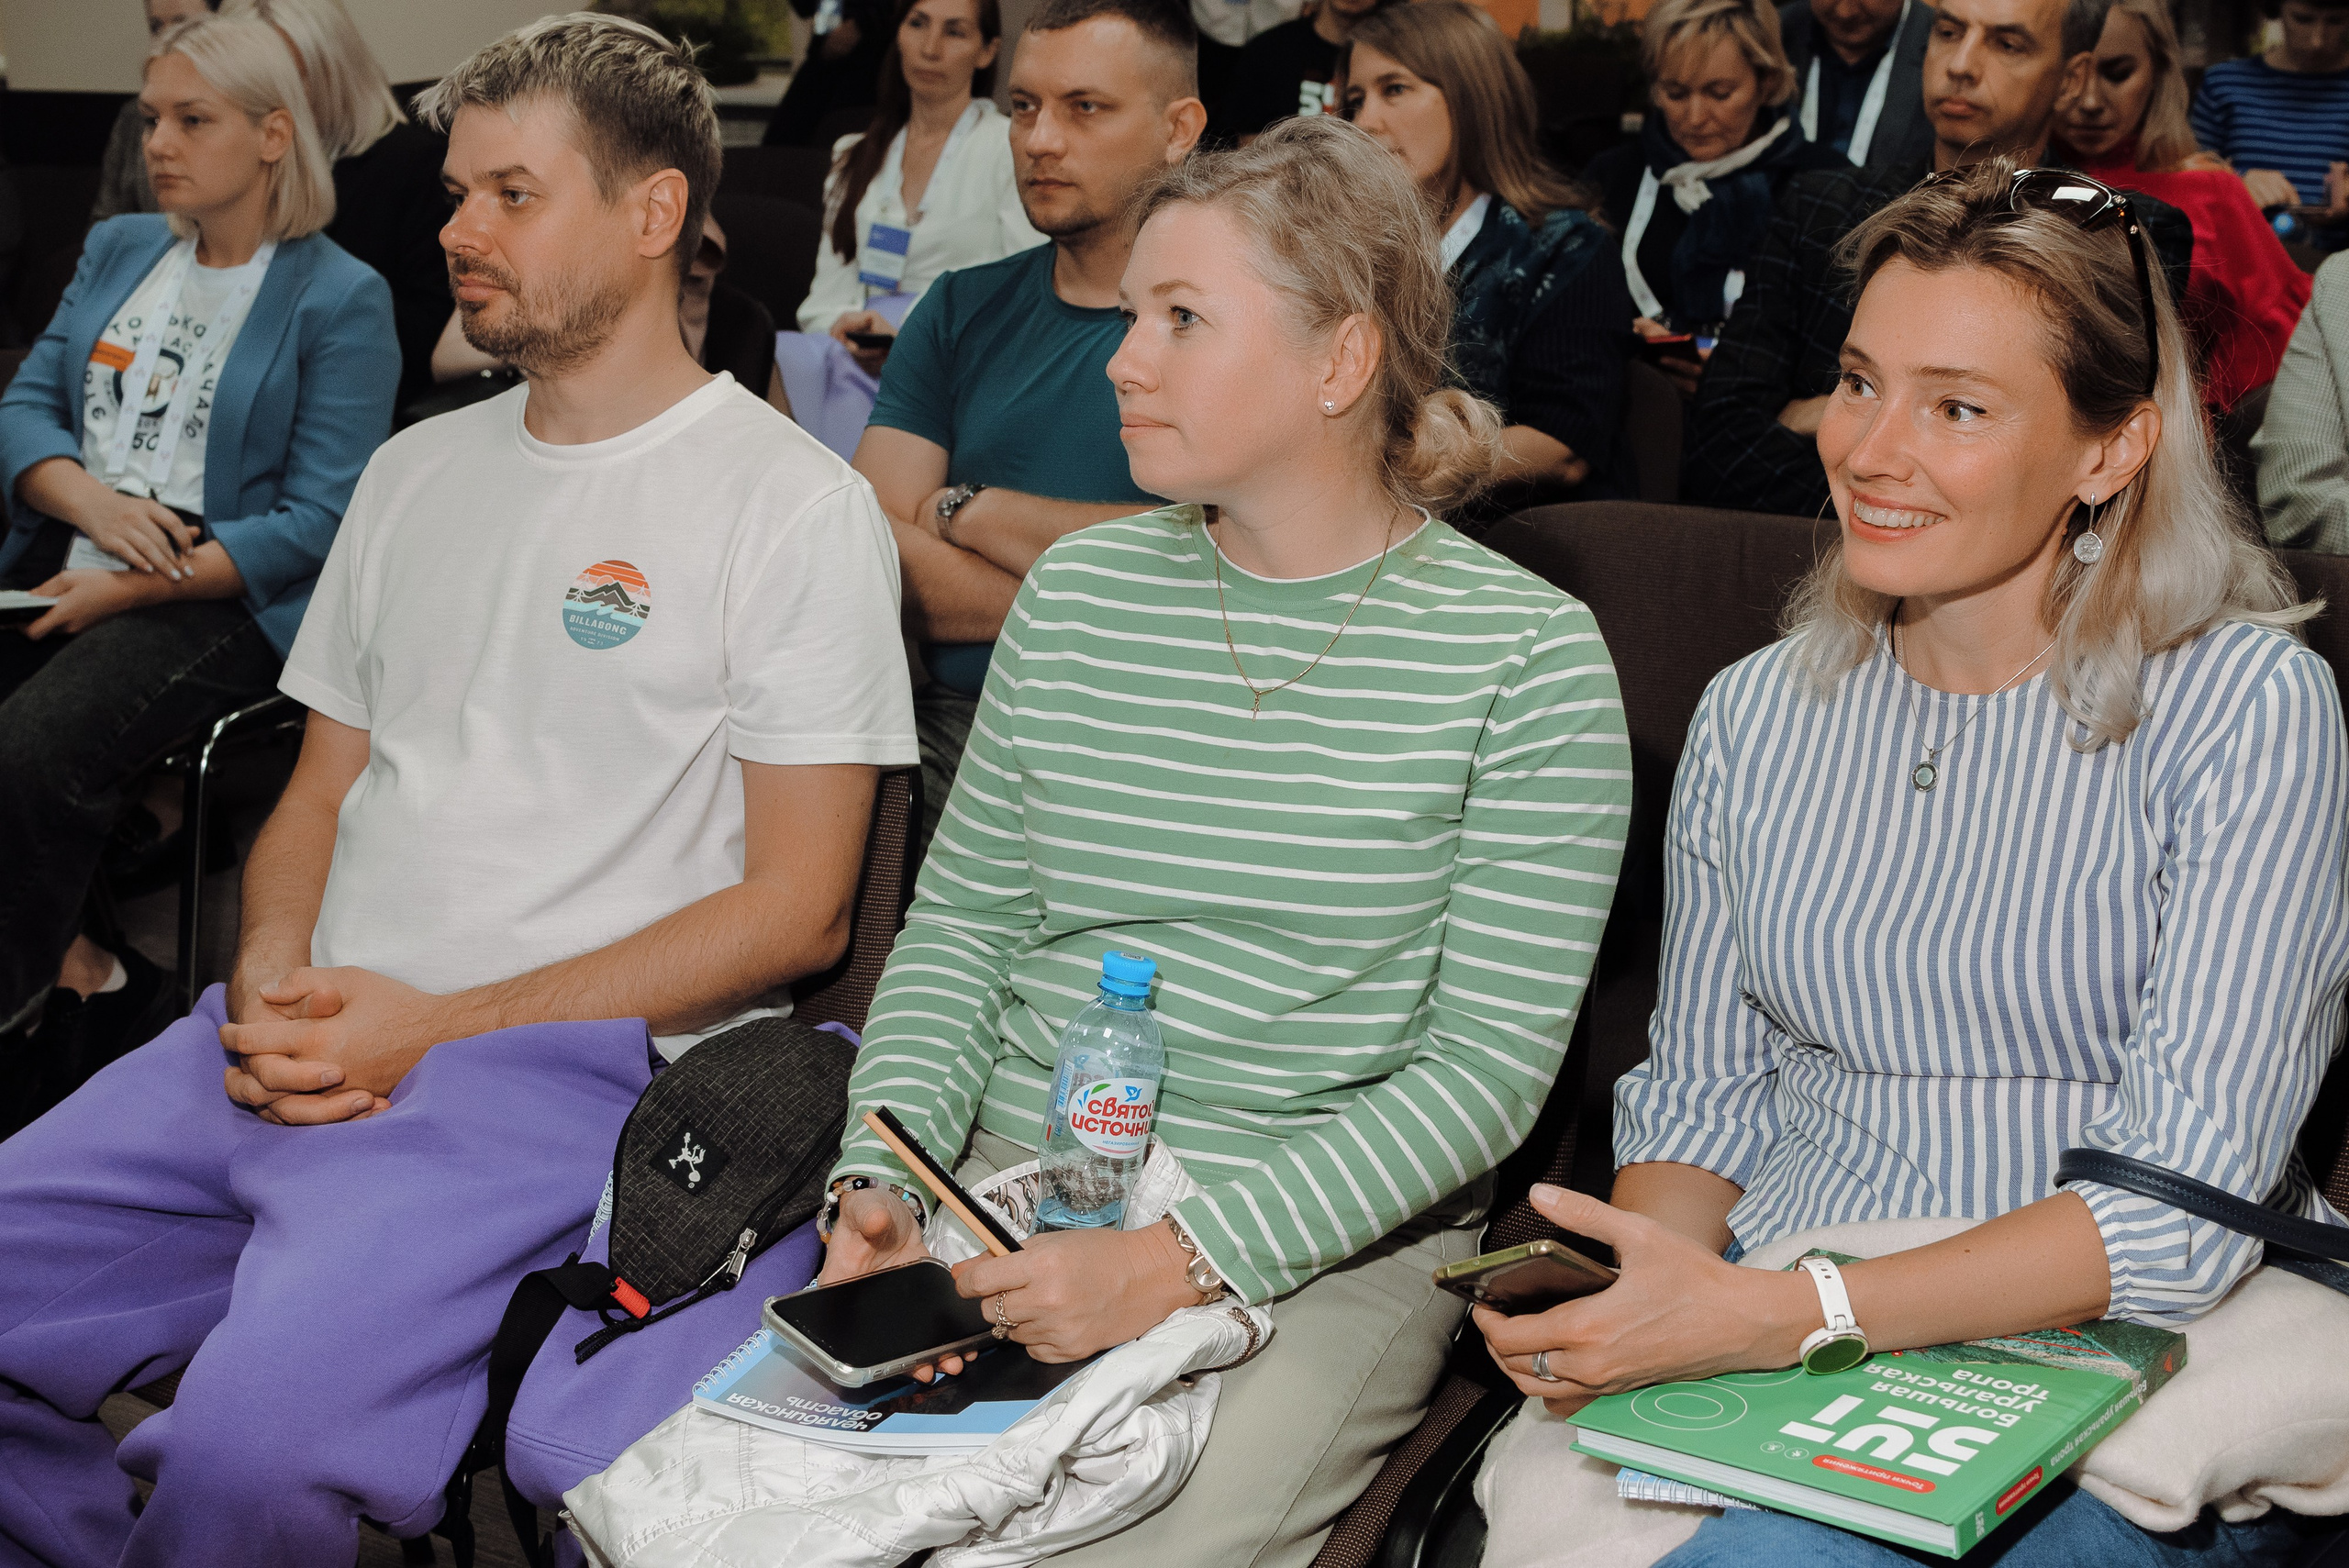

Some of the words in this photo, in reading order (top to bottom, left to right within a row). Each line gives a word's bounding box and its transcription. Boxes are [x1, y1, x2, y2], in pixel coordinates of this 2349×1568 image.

[109, 315, 207, 339] ТОЬКО
[569, 614, 628, 636] BILLABONG
[570, 626, 596, 636] ADVENTURE
[598, 632, 620, 641] DIVISION
[1862, 1362, 2043, 1413] уральская
[1952, 1369, 2050, 1401] тропа
[2114, 1379, 2147, 1411] Большая
[785, 1396, 883, 1420] область
[1869, 1381, 2021, 1428] Большая
[2075, 1404, 2115, 1445] уральская
[2049, 1440, 2075, 1467] тропа
[1821, 1457, 1891, 1482] притяжения
[1891, 1472, 1925, 1490] Точки
